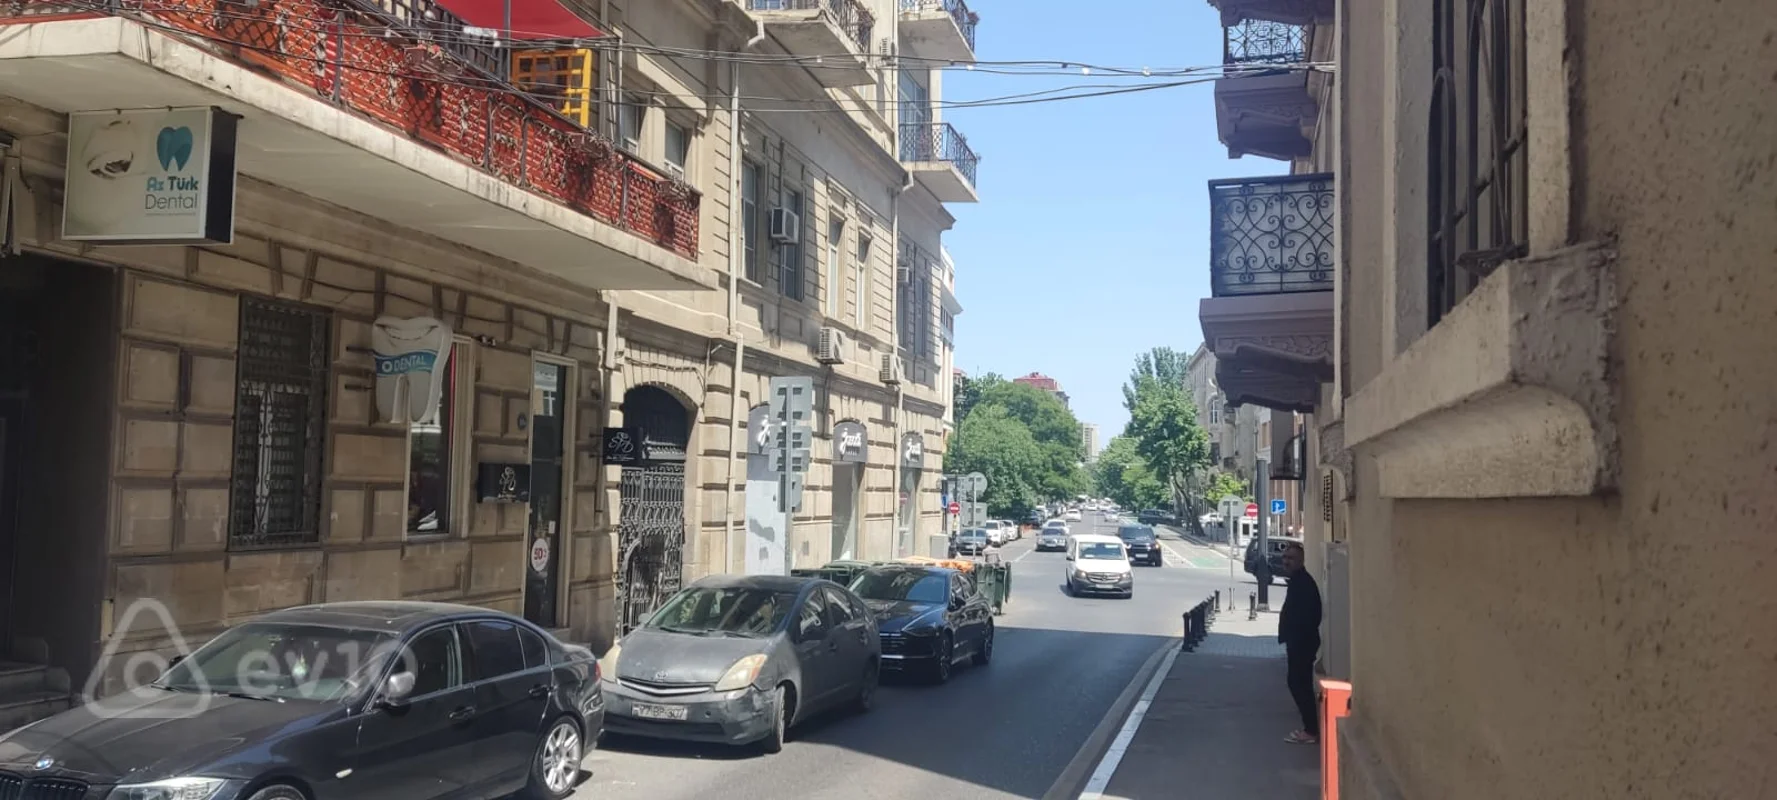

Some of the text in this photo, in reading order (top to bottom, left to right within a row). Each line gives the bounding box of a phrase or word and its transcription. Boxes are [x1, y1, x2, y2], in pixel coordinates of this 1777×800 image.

[147, 175, 199, 191] Az Türk
[145, 193, 198, 209] Dental
[393, 355, 425, 371] DENTAL
